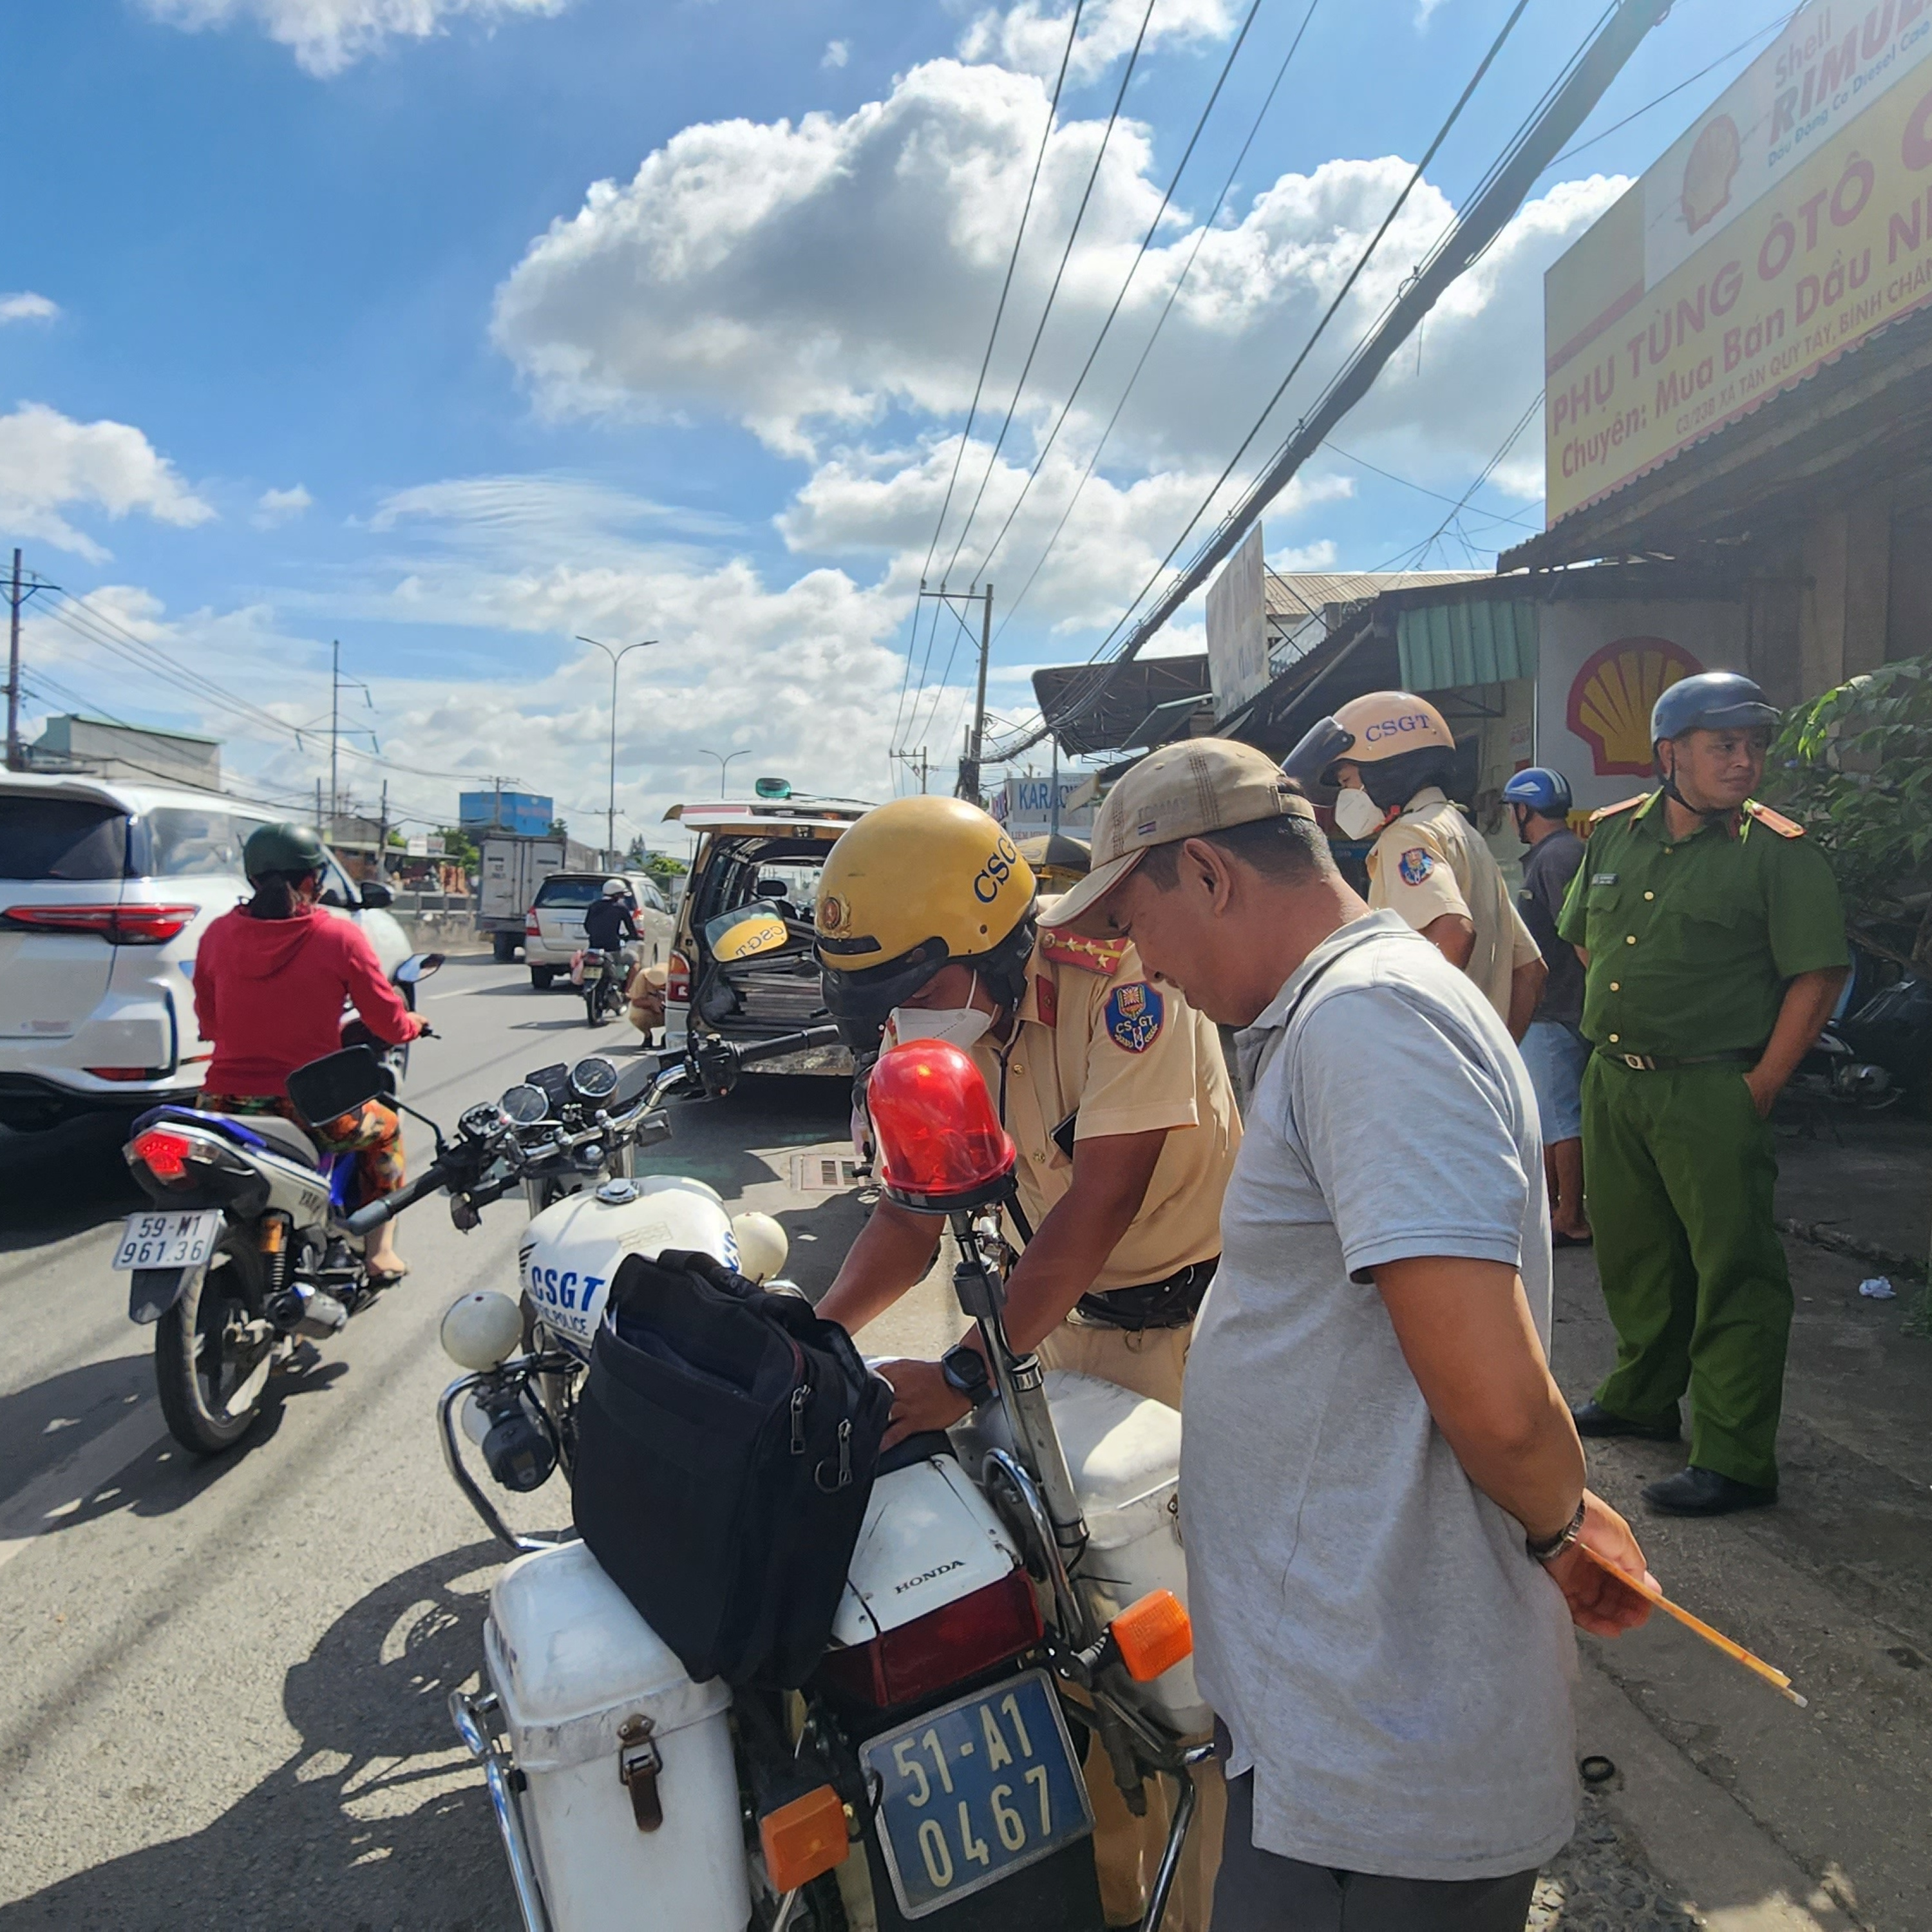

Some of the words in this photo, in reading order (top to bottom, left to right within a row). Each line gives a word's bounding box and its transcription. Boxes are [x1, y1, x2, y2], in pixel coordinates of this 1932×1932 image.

[1769, 0, 1932, 146] RIMUL
[1775, 6, 1832, 90] Shell
[1553, 355, 1615, 437] PHỤ
[1627, 260, 1744, 379] TÙNG
[1757, 150, 1875, 281] ÔTÔ
[1562, 404, 1646, 478] Chuyên:
[1656, 355, 1714, 419] Mua
[1723, 307, 1785, 374] Bán
[1795, 247, 1871, 327] Dầu
[1888, 184, 1932, 265] N
[1365, 714, 1430, 742] CSGT
[973, 829, 1017, 904] CSG
[121, 1239, 204, 1264] 961.36
[138, 1215, 202, 1238] 59-M1
[531, 1265, 606, 1312] CSGT
[895, 1559, 965, 1595] HONDA
[893, 1692, 1034, 1808] 51-A1
[918, 1764, 1052, 1889] 0467
